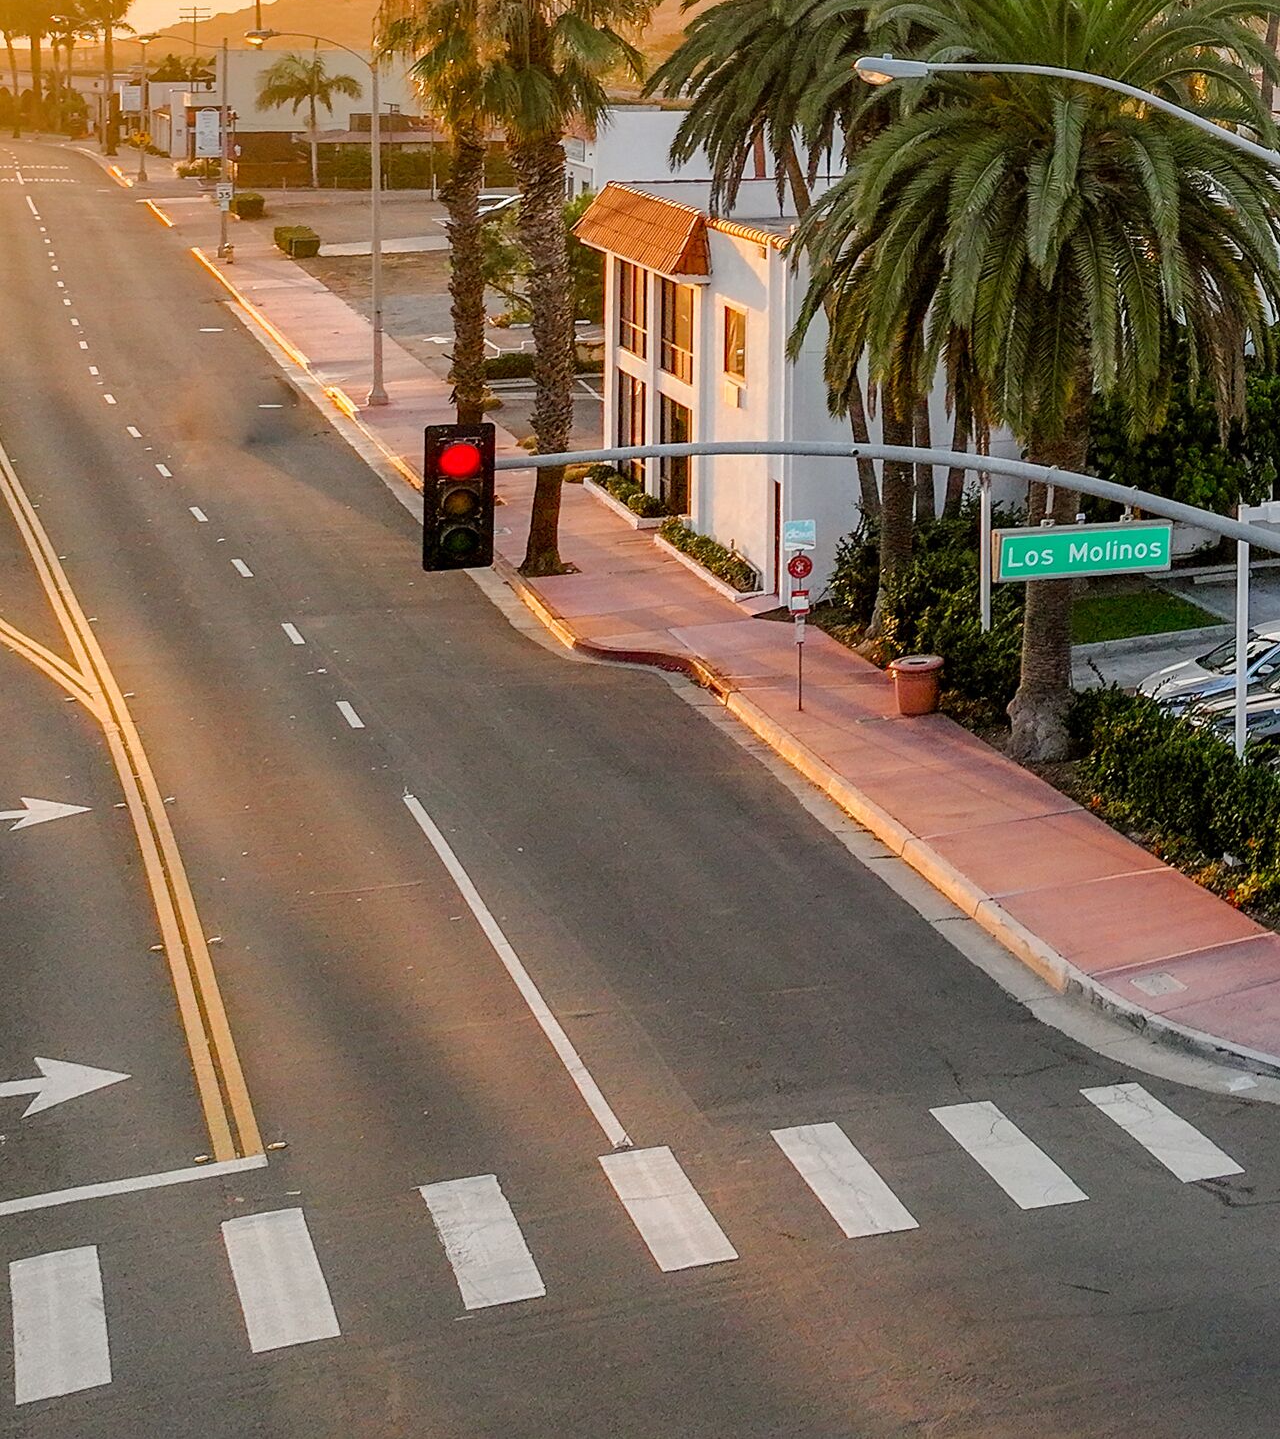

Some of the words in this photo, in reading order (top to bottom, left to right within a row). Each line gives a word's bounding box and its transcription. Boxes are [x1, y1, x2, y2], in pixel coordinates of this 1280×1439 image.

[218, 191, 231, 199] 35
[1007, 547, 1054, 568] Los
[1068, 540, 1162, 563] Molinos
